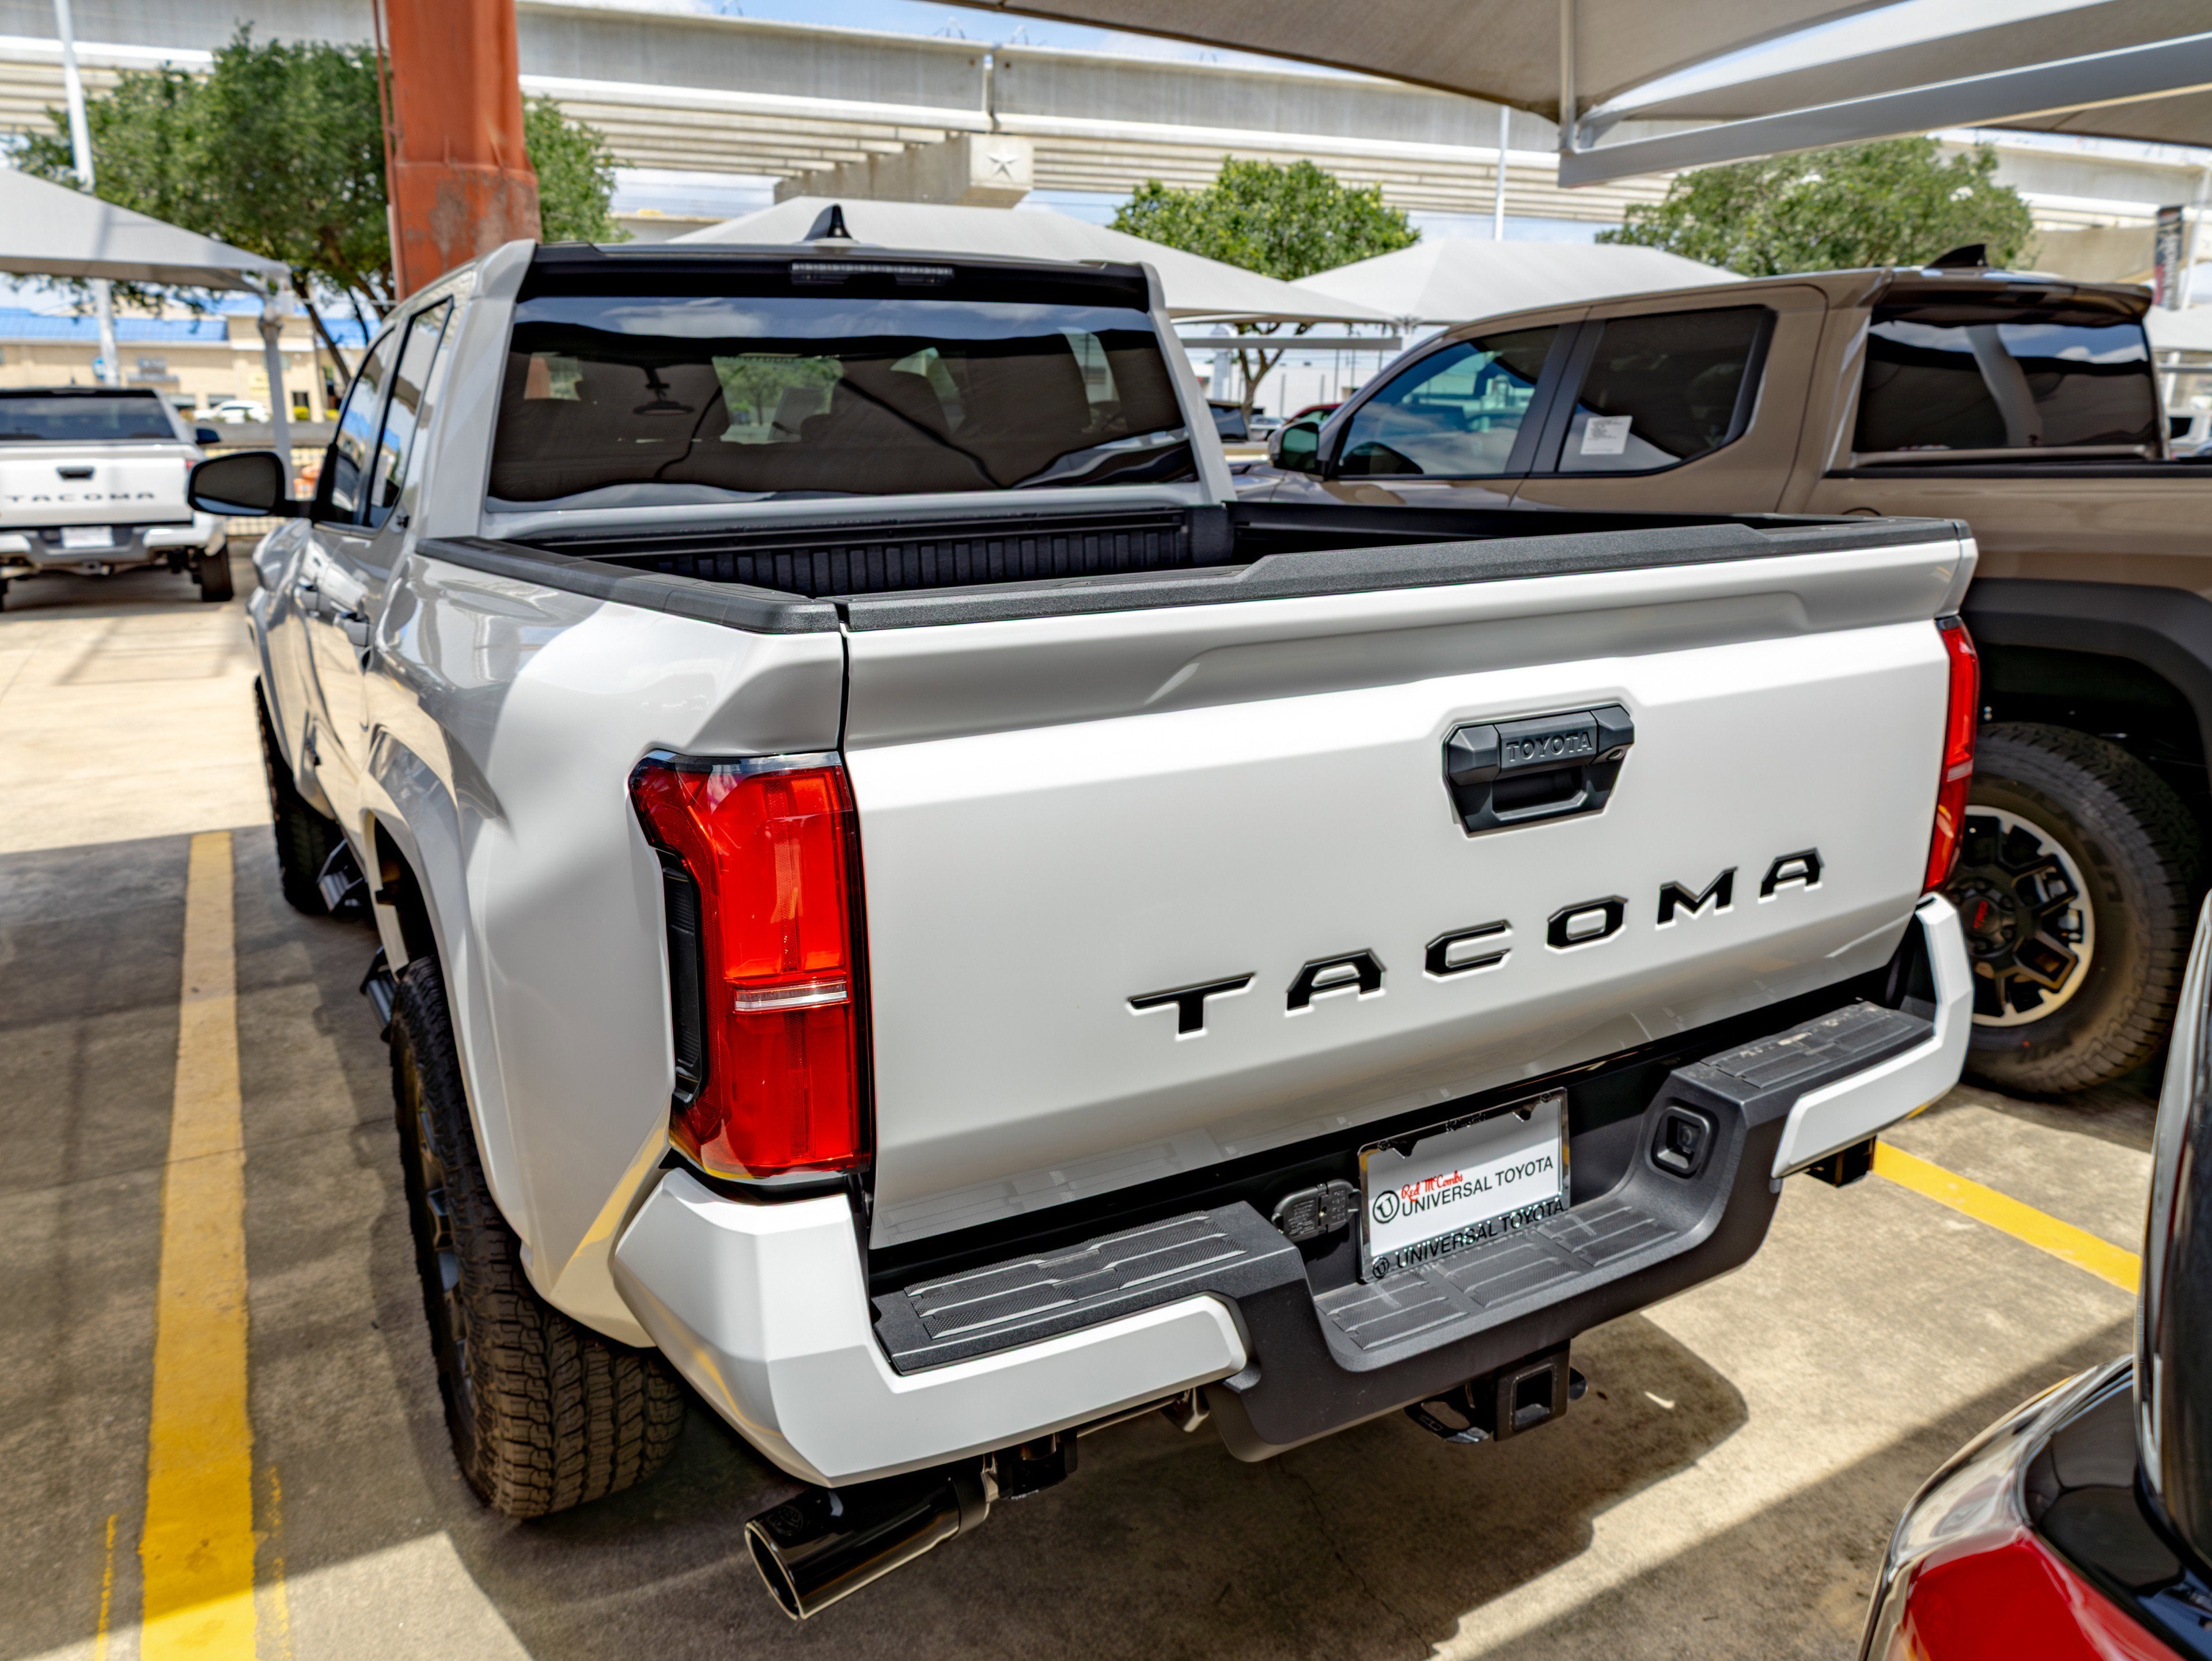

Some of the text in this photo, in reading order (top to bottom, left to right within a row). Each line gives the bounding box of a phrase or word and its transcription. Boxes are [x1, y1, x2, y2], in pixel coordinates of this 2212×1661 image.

[6, 493, 154, 502] TACOMA
[1506, 731, 1593, 762] TOYOTA
[1127, 848, 1824, 1035] TACOMA
[1401, 1182, 1420, 1202] Red
[1402, 1156, 1554, 1217] UNIVERSAL TOYOTA
[1395, 1199, 1564, 1268] UNIVERSAL TOYOTA
